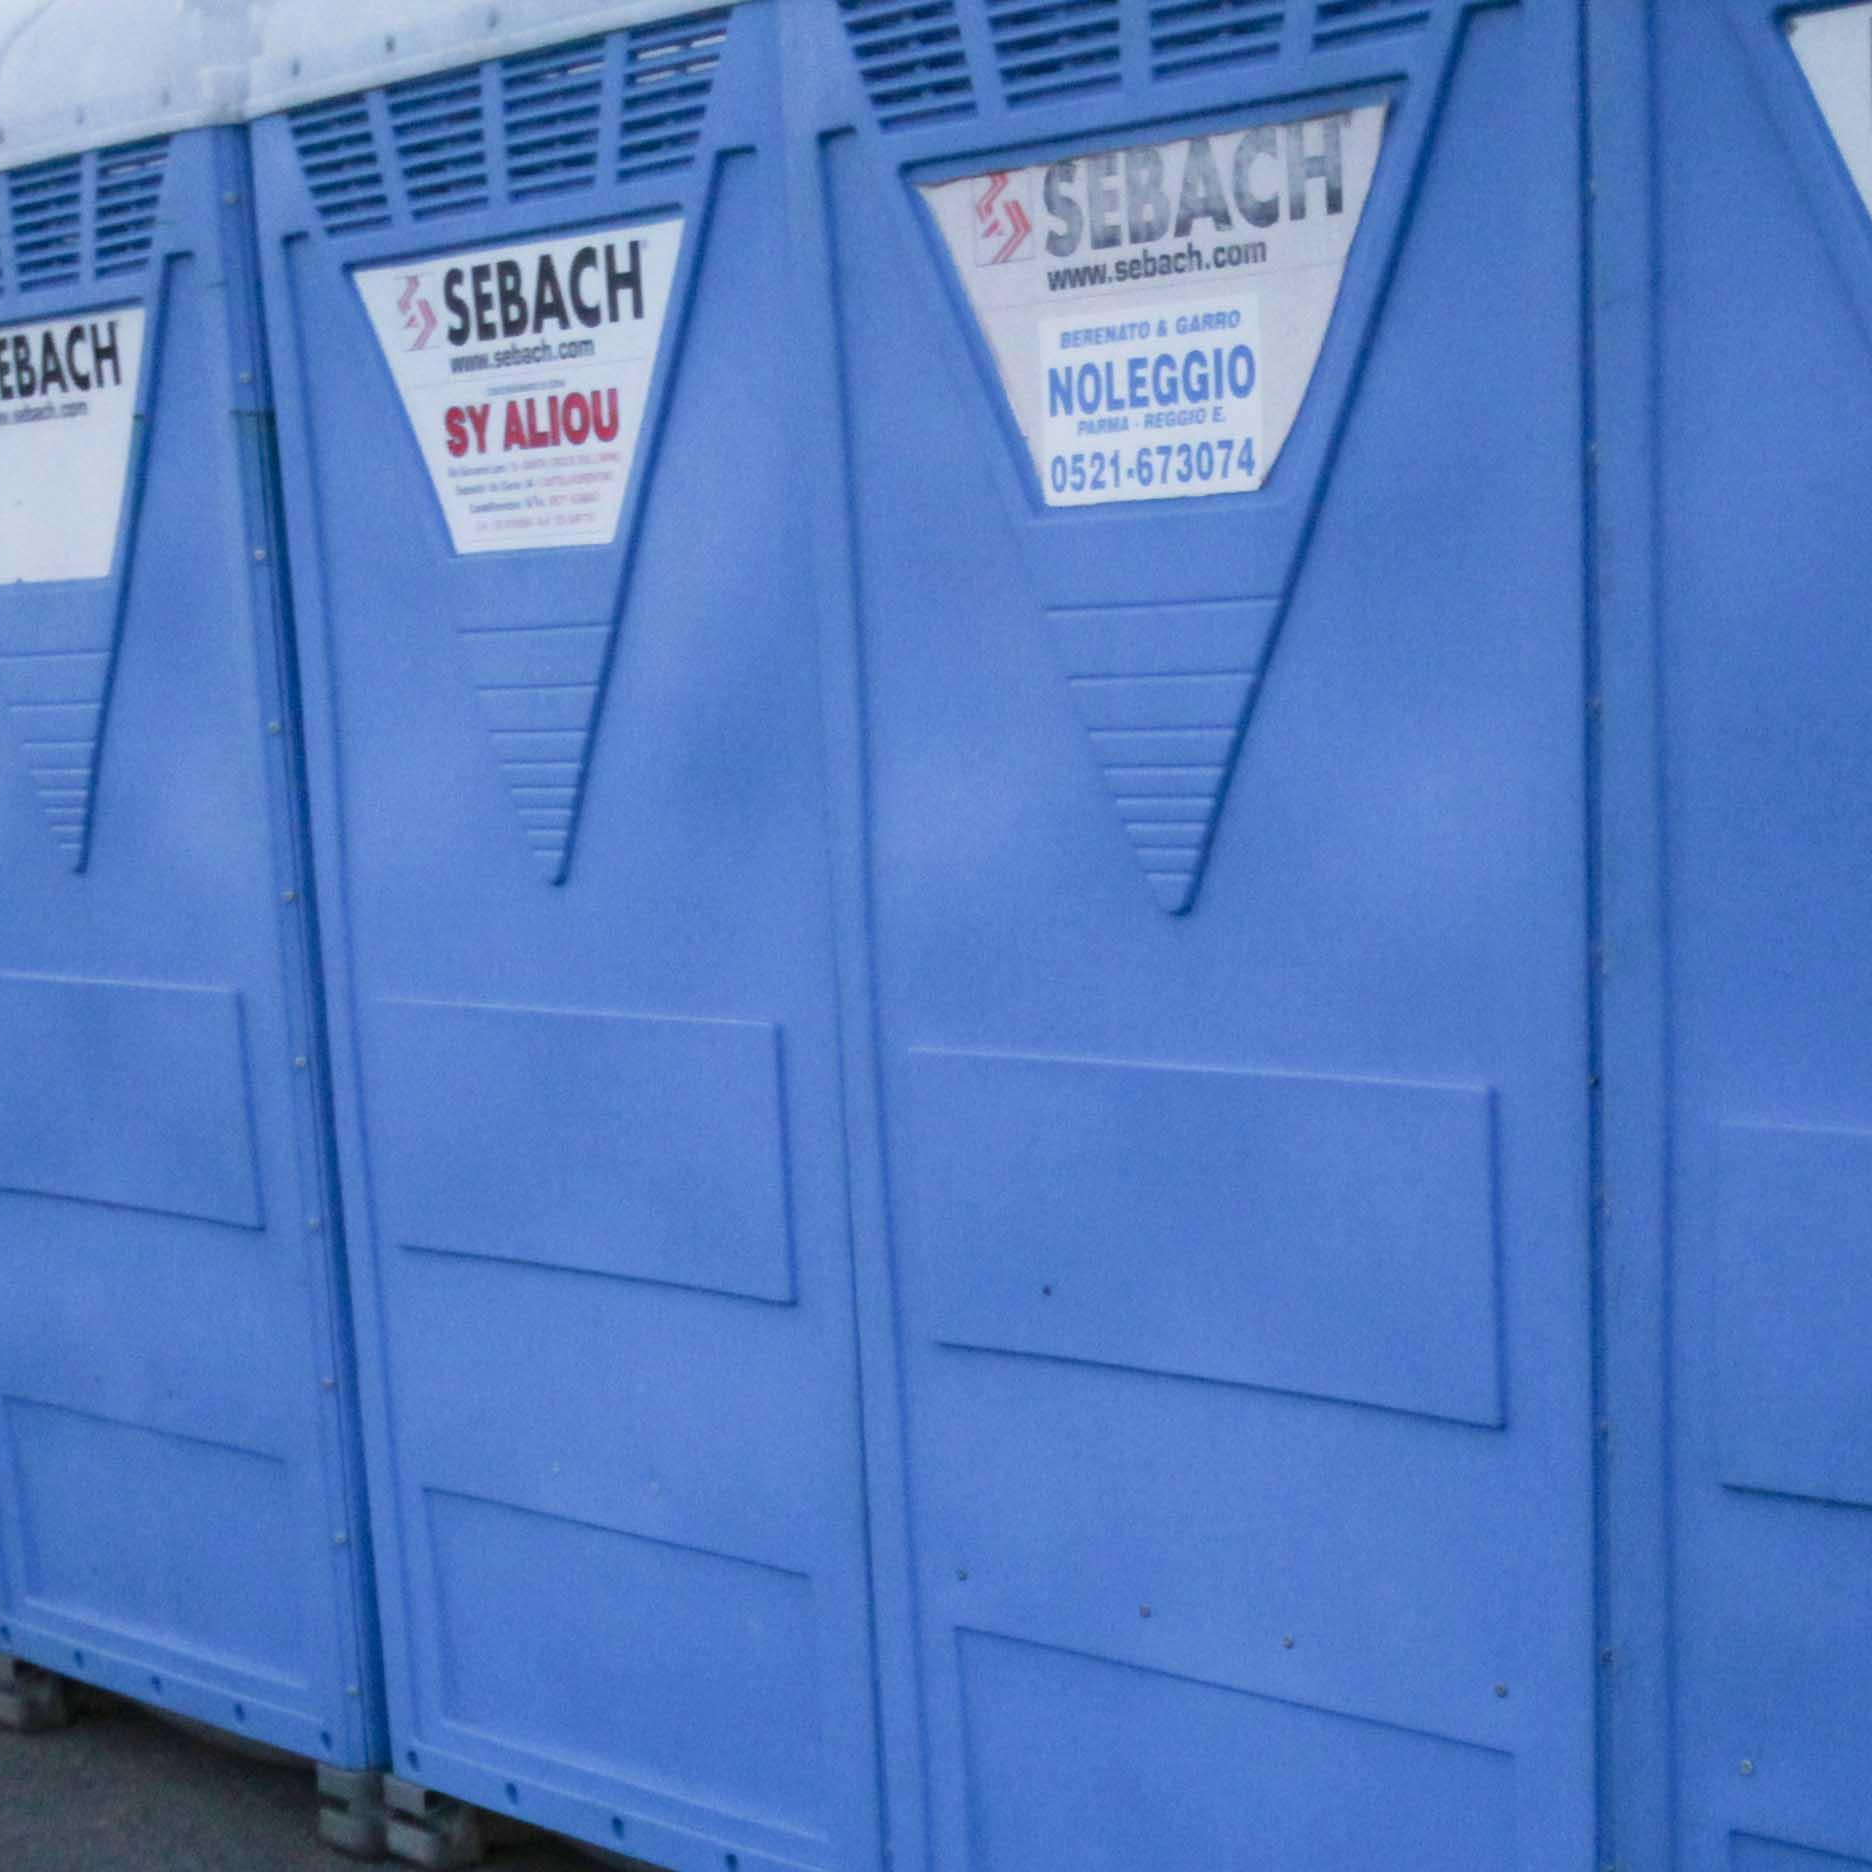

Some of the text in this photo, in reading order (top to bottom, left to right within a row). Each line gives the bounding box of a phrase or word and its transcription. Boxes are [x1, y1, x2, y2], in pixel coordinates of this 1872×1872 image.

[1043, 114, 1343, 257] SEBACH
[444, 240, 644, 347] SEBACH
[1046, 241, 1267, 291] www.sebach.com
[1060, 310, 1241, 349] BERENATO & GARRO
[1048, 344, 1256, 417] NOLEGGIO
[445, 388, 620, 458] SY ALIOU
[1050, 437, 1256, 494] 0521-673074
